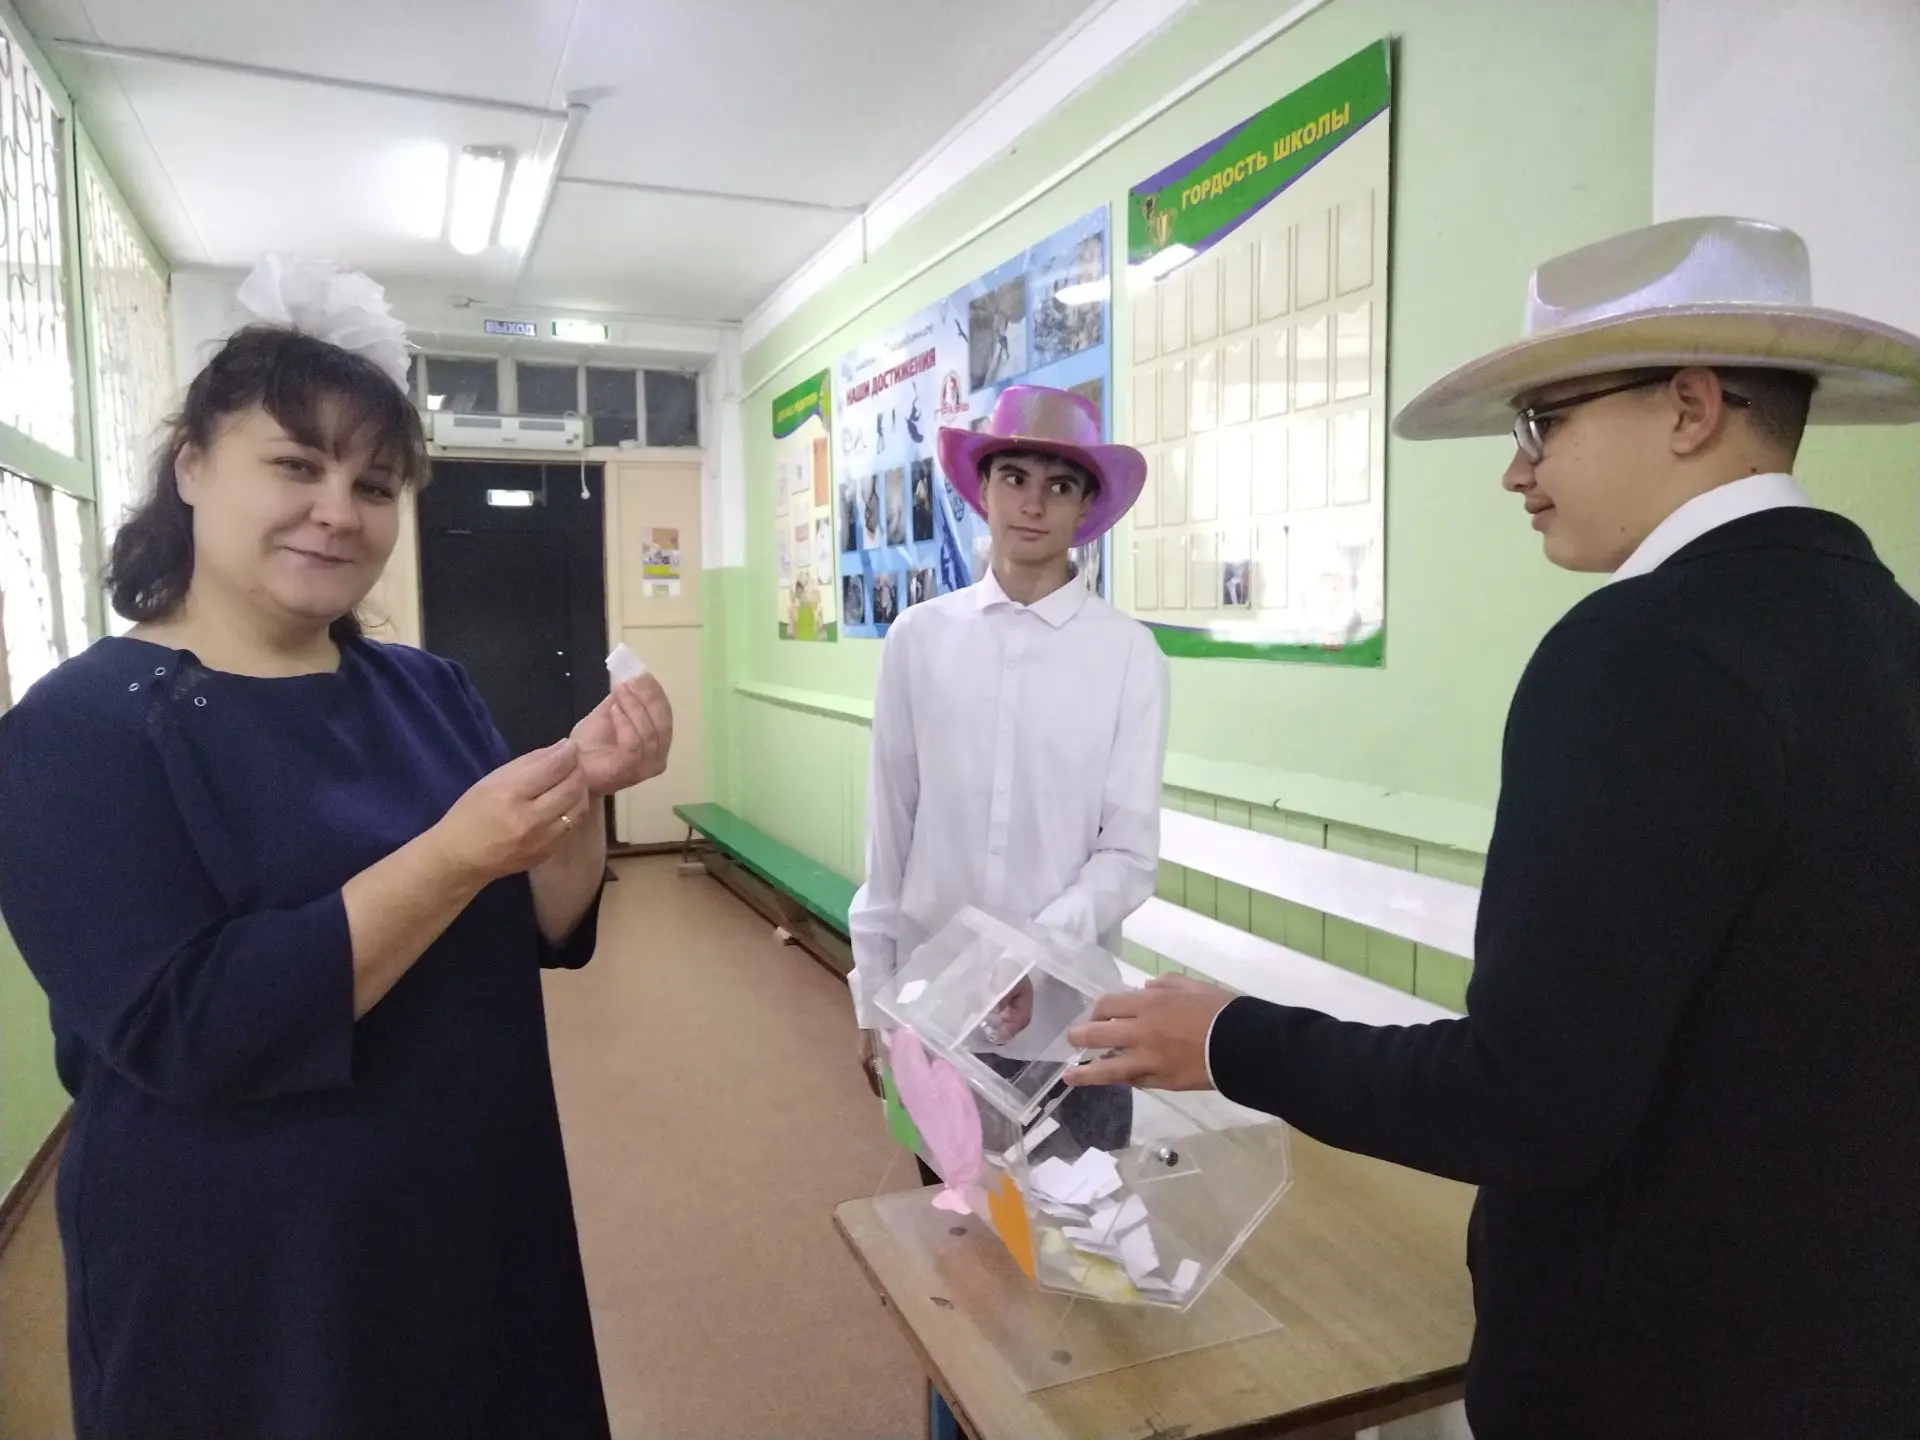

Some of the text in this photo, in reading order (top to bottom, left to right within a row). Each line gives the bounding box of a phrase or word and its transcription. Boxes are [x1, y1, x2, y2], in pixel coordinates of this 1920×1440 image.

[1181, 103, 1350, 210] ГОРДОСТЬ ШКОЛЫ
[486, 320, 536, 336] ВЫХОД
[846, 380, 870, 407] НАШИ
[871, 346, 936, 398] ДОСТИЖЕНИЯ
